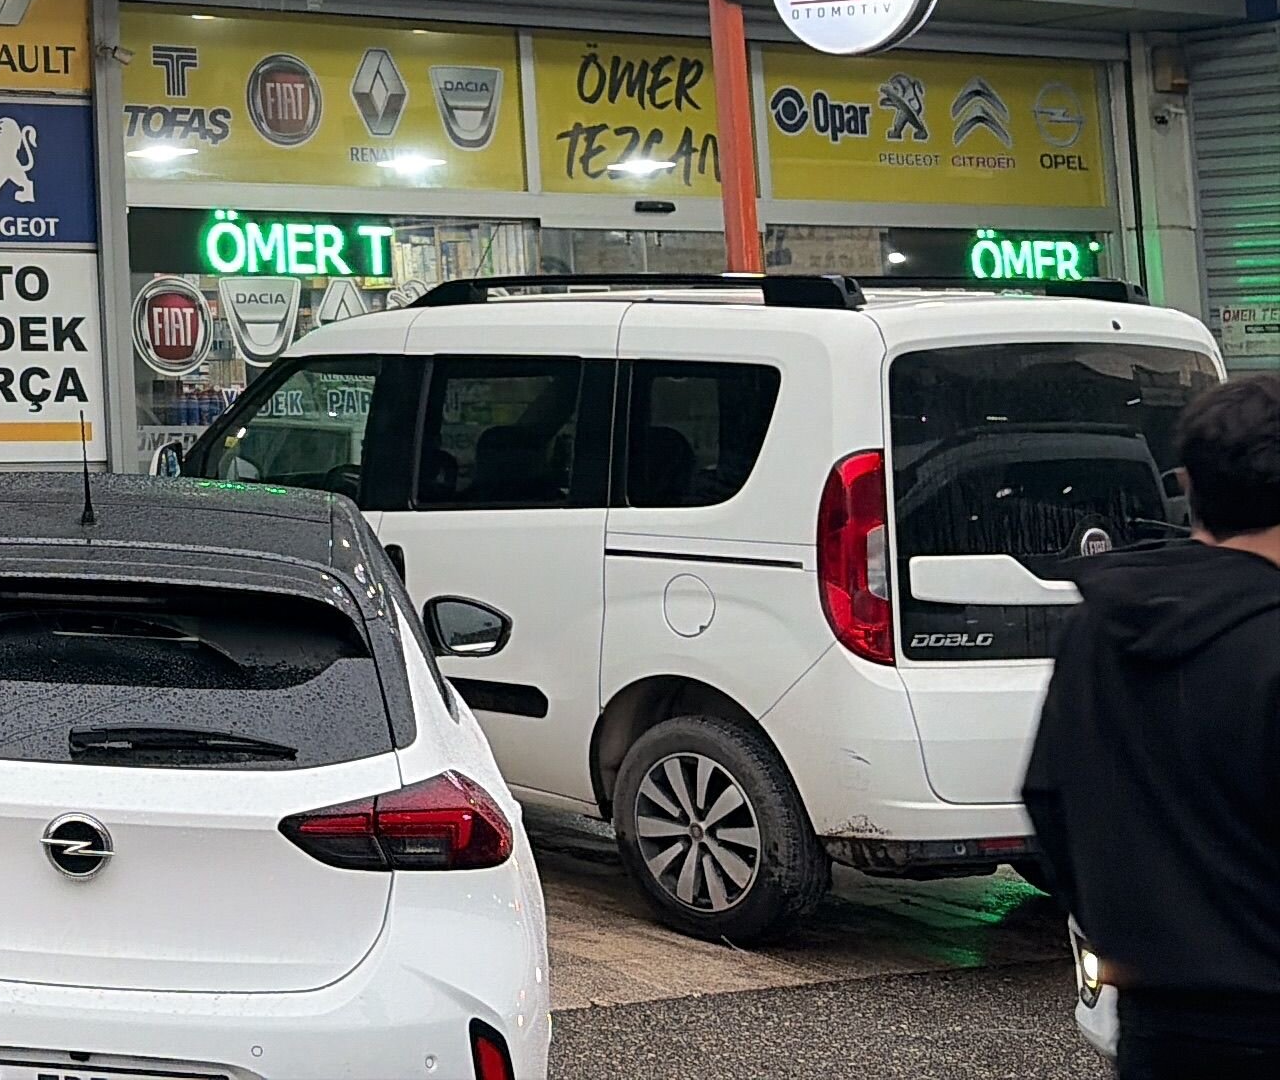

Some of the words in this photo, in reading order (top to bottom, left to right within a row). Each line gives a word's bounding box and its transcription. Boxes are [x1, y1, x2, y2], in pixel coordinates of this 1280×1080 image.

[443, 79, 490, 93] DACIA
[577, 42, 704, 112] ÖMER
[265, 81, 306, 121] FIAT
[123, 105, 232, 145] TOFAŞ
[812, 92, 871, 143] Opar
[878, 152, 941, 167] PEUGEOT
[951, 153, 1016, 169] CITROËN
[1039, 153, 1089, 171] OPEL
[205, 208, 351, 275] ÖMER
[357, 225, 392, 275] T
[235, 292, 286, 307] DACIA
[153, 305, 195, 348] FIAT
[910, 633, 994, 648] DOBLO
